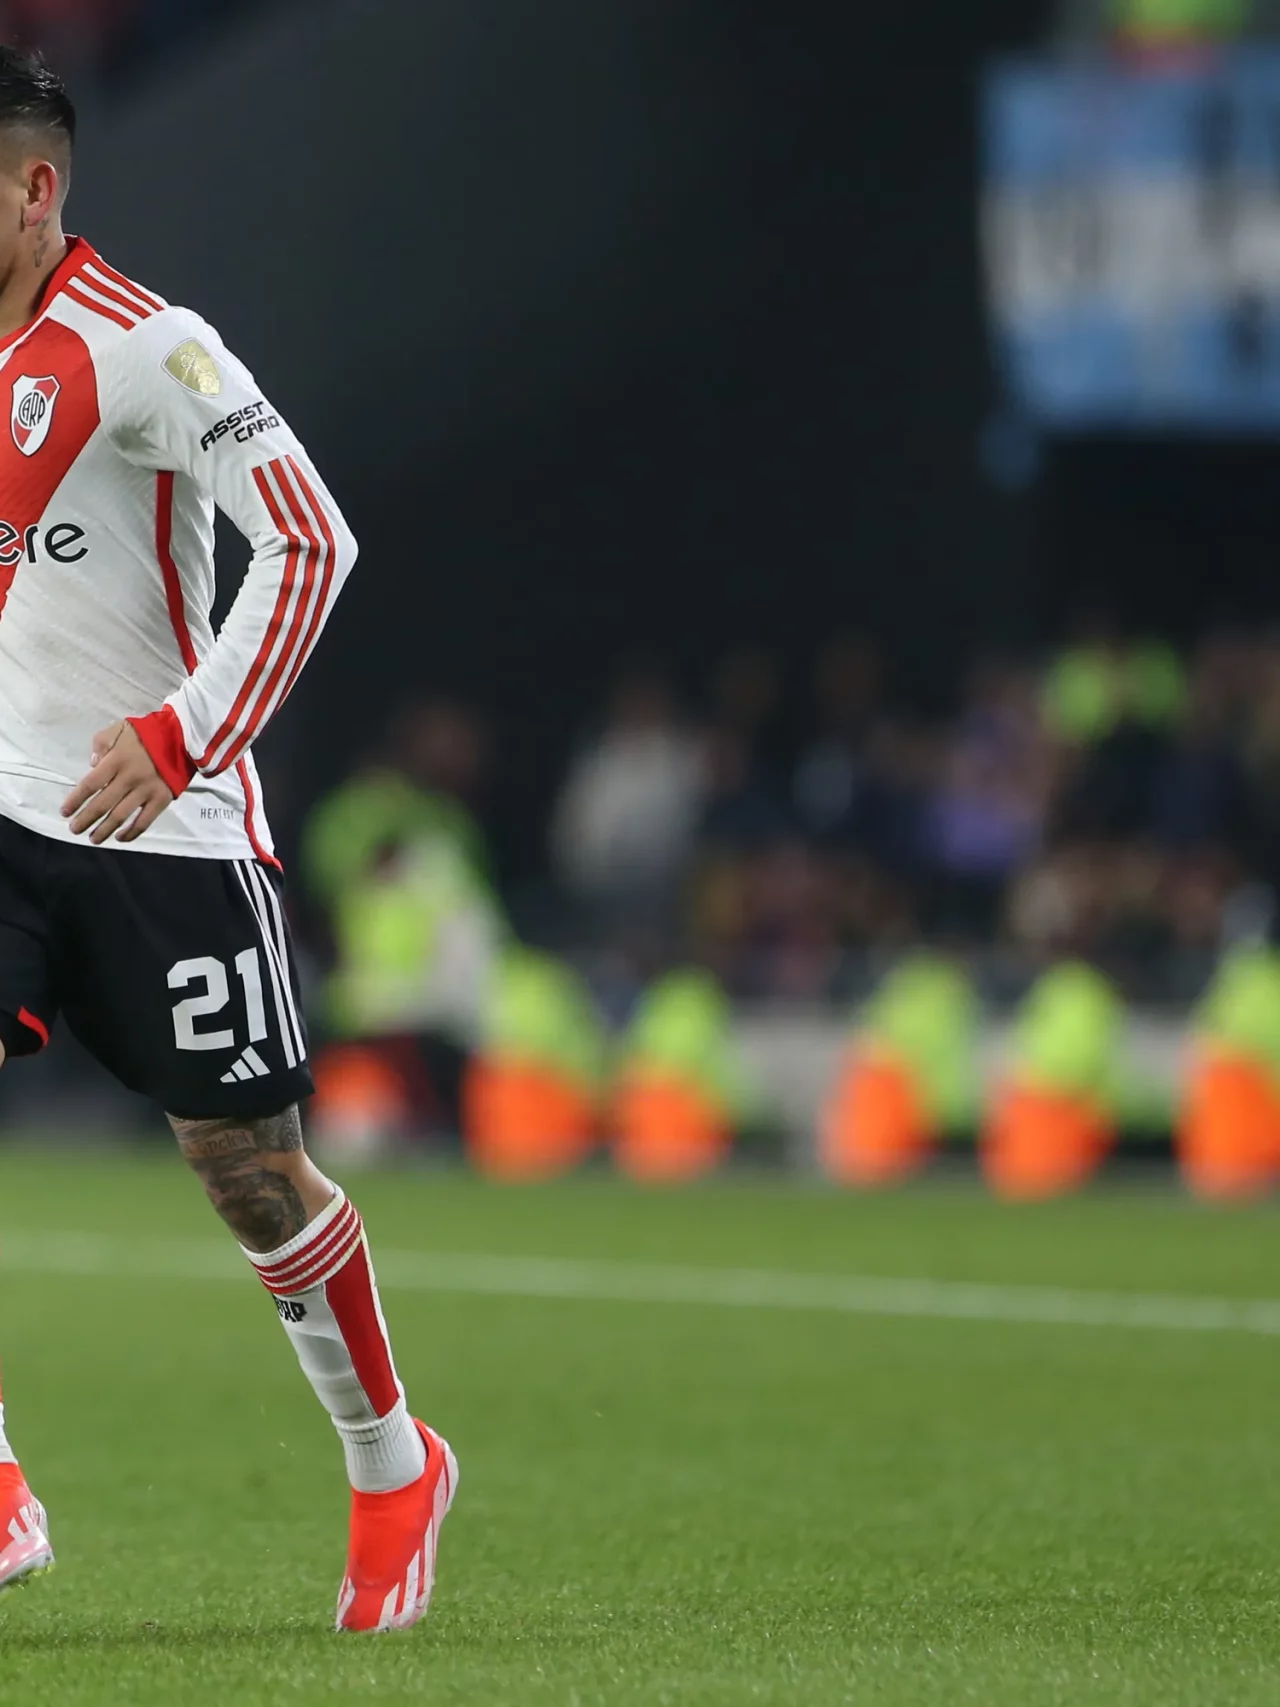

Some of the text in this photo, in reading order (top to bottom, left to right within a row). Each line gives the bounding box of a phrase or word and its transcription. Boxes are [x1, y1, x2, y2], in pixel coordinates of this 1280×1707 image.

[200, 401, 264, 452] ASSIST
[234, 415, 280, 443] CARD
[166, 947, 268, 1051] 21
